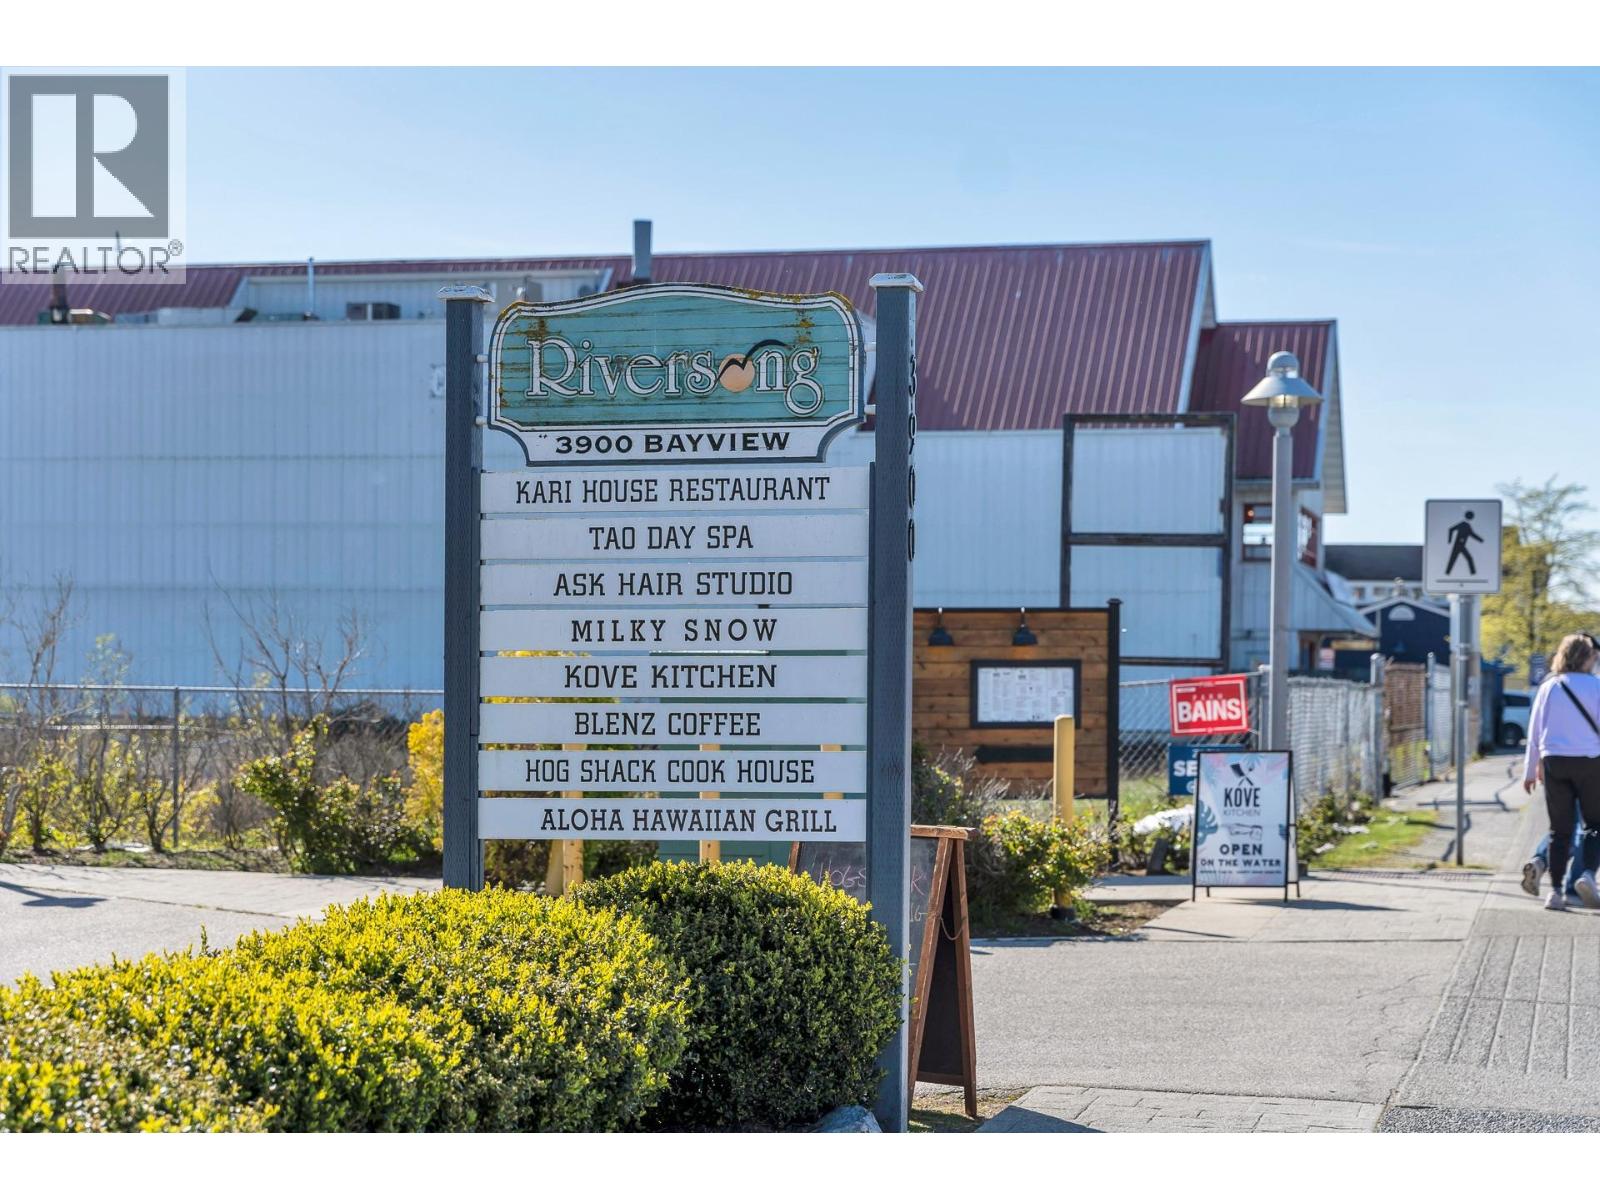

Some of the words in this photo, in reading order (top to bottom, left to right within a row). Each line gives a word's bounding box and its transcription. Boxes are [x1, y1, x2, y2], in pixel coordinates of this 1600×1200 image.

[555, 435, 633, 454] 3900
[644, 432, 790, 453] BAYVIEW
[516, 480, 572, 504] KARI
[582, 478, 658, 503] HOUSE
[669, 476, 830, 502] RESTAURANT
[589, 526, 636, 550] TAO
[647, 525, 696, 550] DAY
[707, 524, 754, 549] SPA
[553, 572, 606, 597] ASK
[617, 572, 683, 596] HAIR
[696, 571, 793, 596] STUDIO
[571, 619, 666, 642] MILKY
[684, 618, 778, 642] SNOW
[564, 664, 638, 689] KOVE
[651, 664, 778, 689] KITCHEN
[1177, 698, 1242, 723] BAINS
[574, 711, 656, 736] BLENZ
[668, 712, 761, 736] COFFEE
[525, 759, 569, 783] HOG
[580, 759, 657, 783] SHACK
[667, 759, 726, 783] COOK
[736, 759, 815, 784] HOUSE
[1224, 787, 1261, 808] KOVE
[540, 808, 625, 832] ALOHA
[632, 808, 756, 832] HAWAIIAN
[765, 809, 837, 833] GRILL
[1219, 843, 1263, 856] OPEN
[1218, 859, 1238, 867] THE
[1243, 859, 1281, 867] WATER
